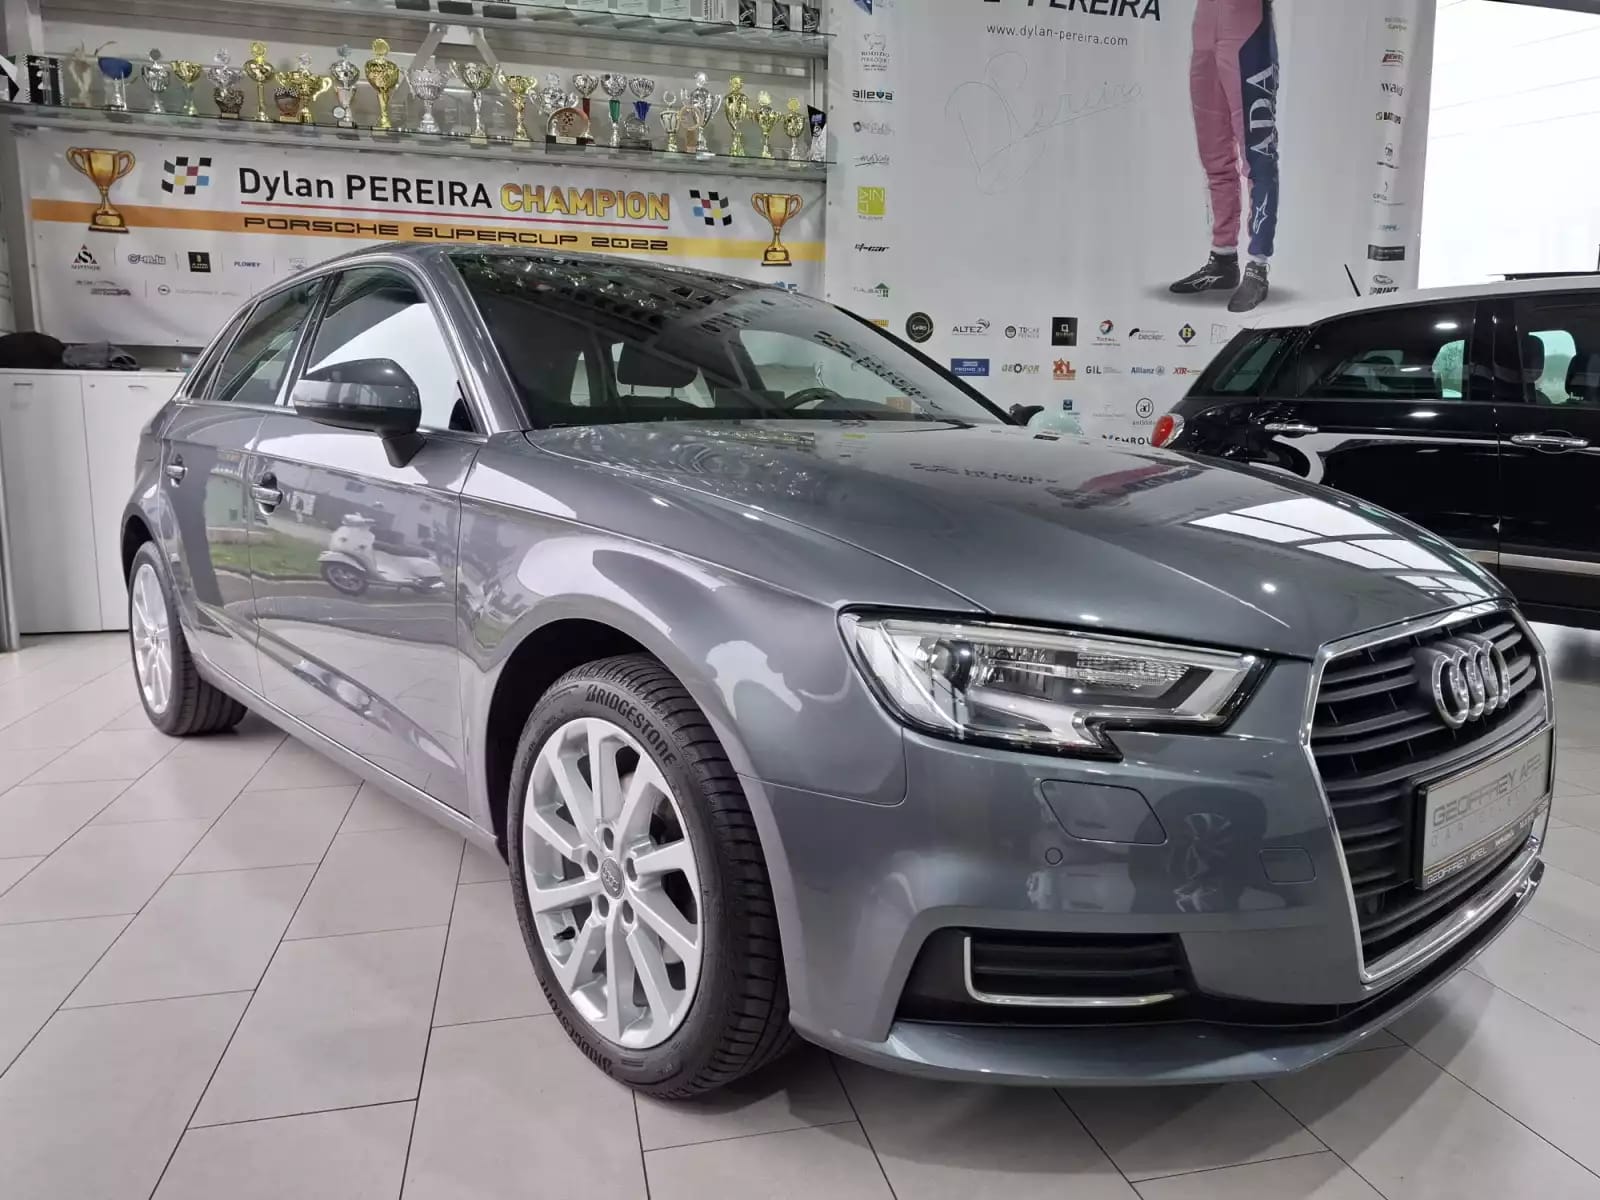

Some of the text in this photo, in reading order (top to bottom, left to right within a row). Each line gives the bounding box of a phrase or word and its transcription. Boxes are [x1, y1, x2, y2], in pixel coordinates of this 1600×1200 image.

[986, 24, 1129, 46] www.dylan-pereira.com
[238, 167, 671, 221] Dylan PEREIRA CHAMPION
[243, 217, 669, 251] PORSCHE SUPERCUP 2022
[1085, 365, 1102, 374] GIL
[1130, 366, 1155, 375] Allianz
[584, 683, 678, 769] BRIDGESTONE
